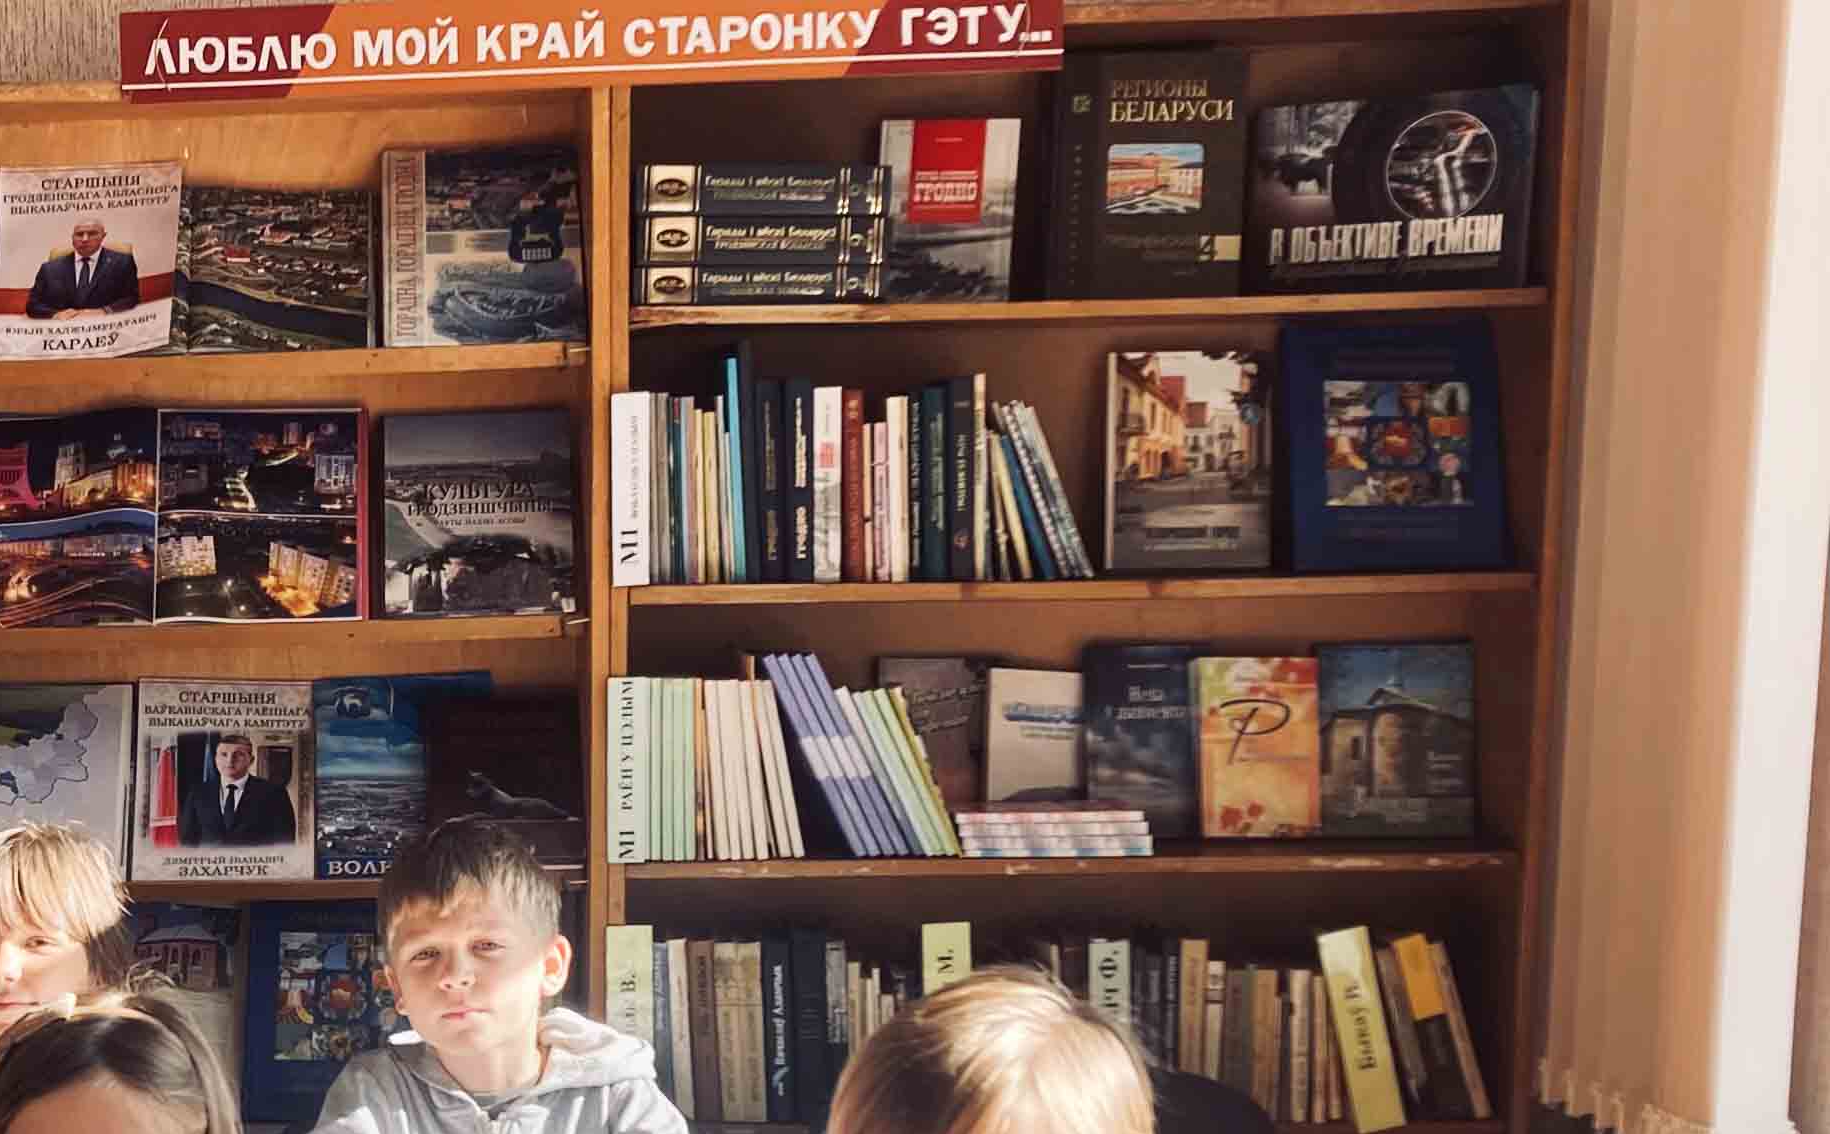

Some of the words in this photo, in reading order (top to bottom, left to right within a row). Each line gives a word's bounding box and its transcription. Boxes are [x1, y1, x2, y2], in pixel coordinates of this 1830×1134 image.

[145, 31, 338, 76] ЛЮБЛЮ
[352, 16, 460, 67] МОЙ
[476, 9, 606, 63] КРАЙ
[623, 7, 881, 57] СТАРОНКУ
[1108, 99, 1234, 123] БЕЛАРУСИ
[178, 690, 277, 704] СТАРШЫНЯ
[178, 865, 270, 877] ЗАХАРЧУК
[938, 949, 955, 975] М.
[1101, 948, 1119, 977] Ф.
